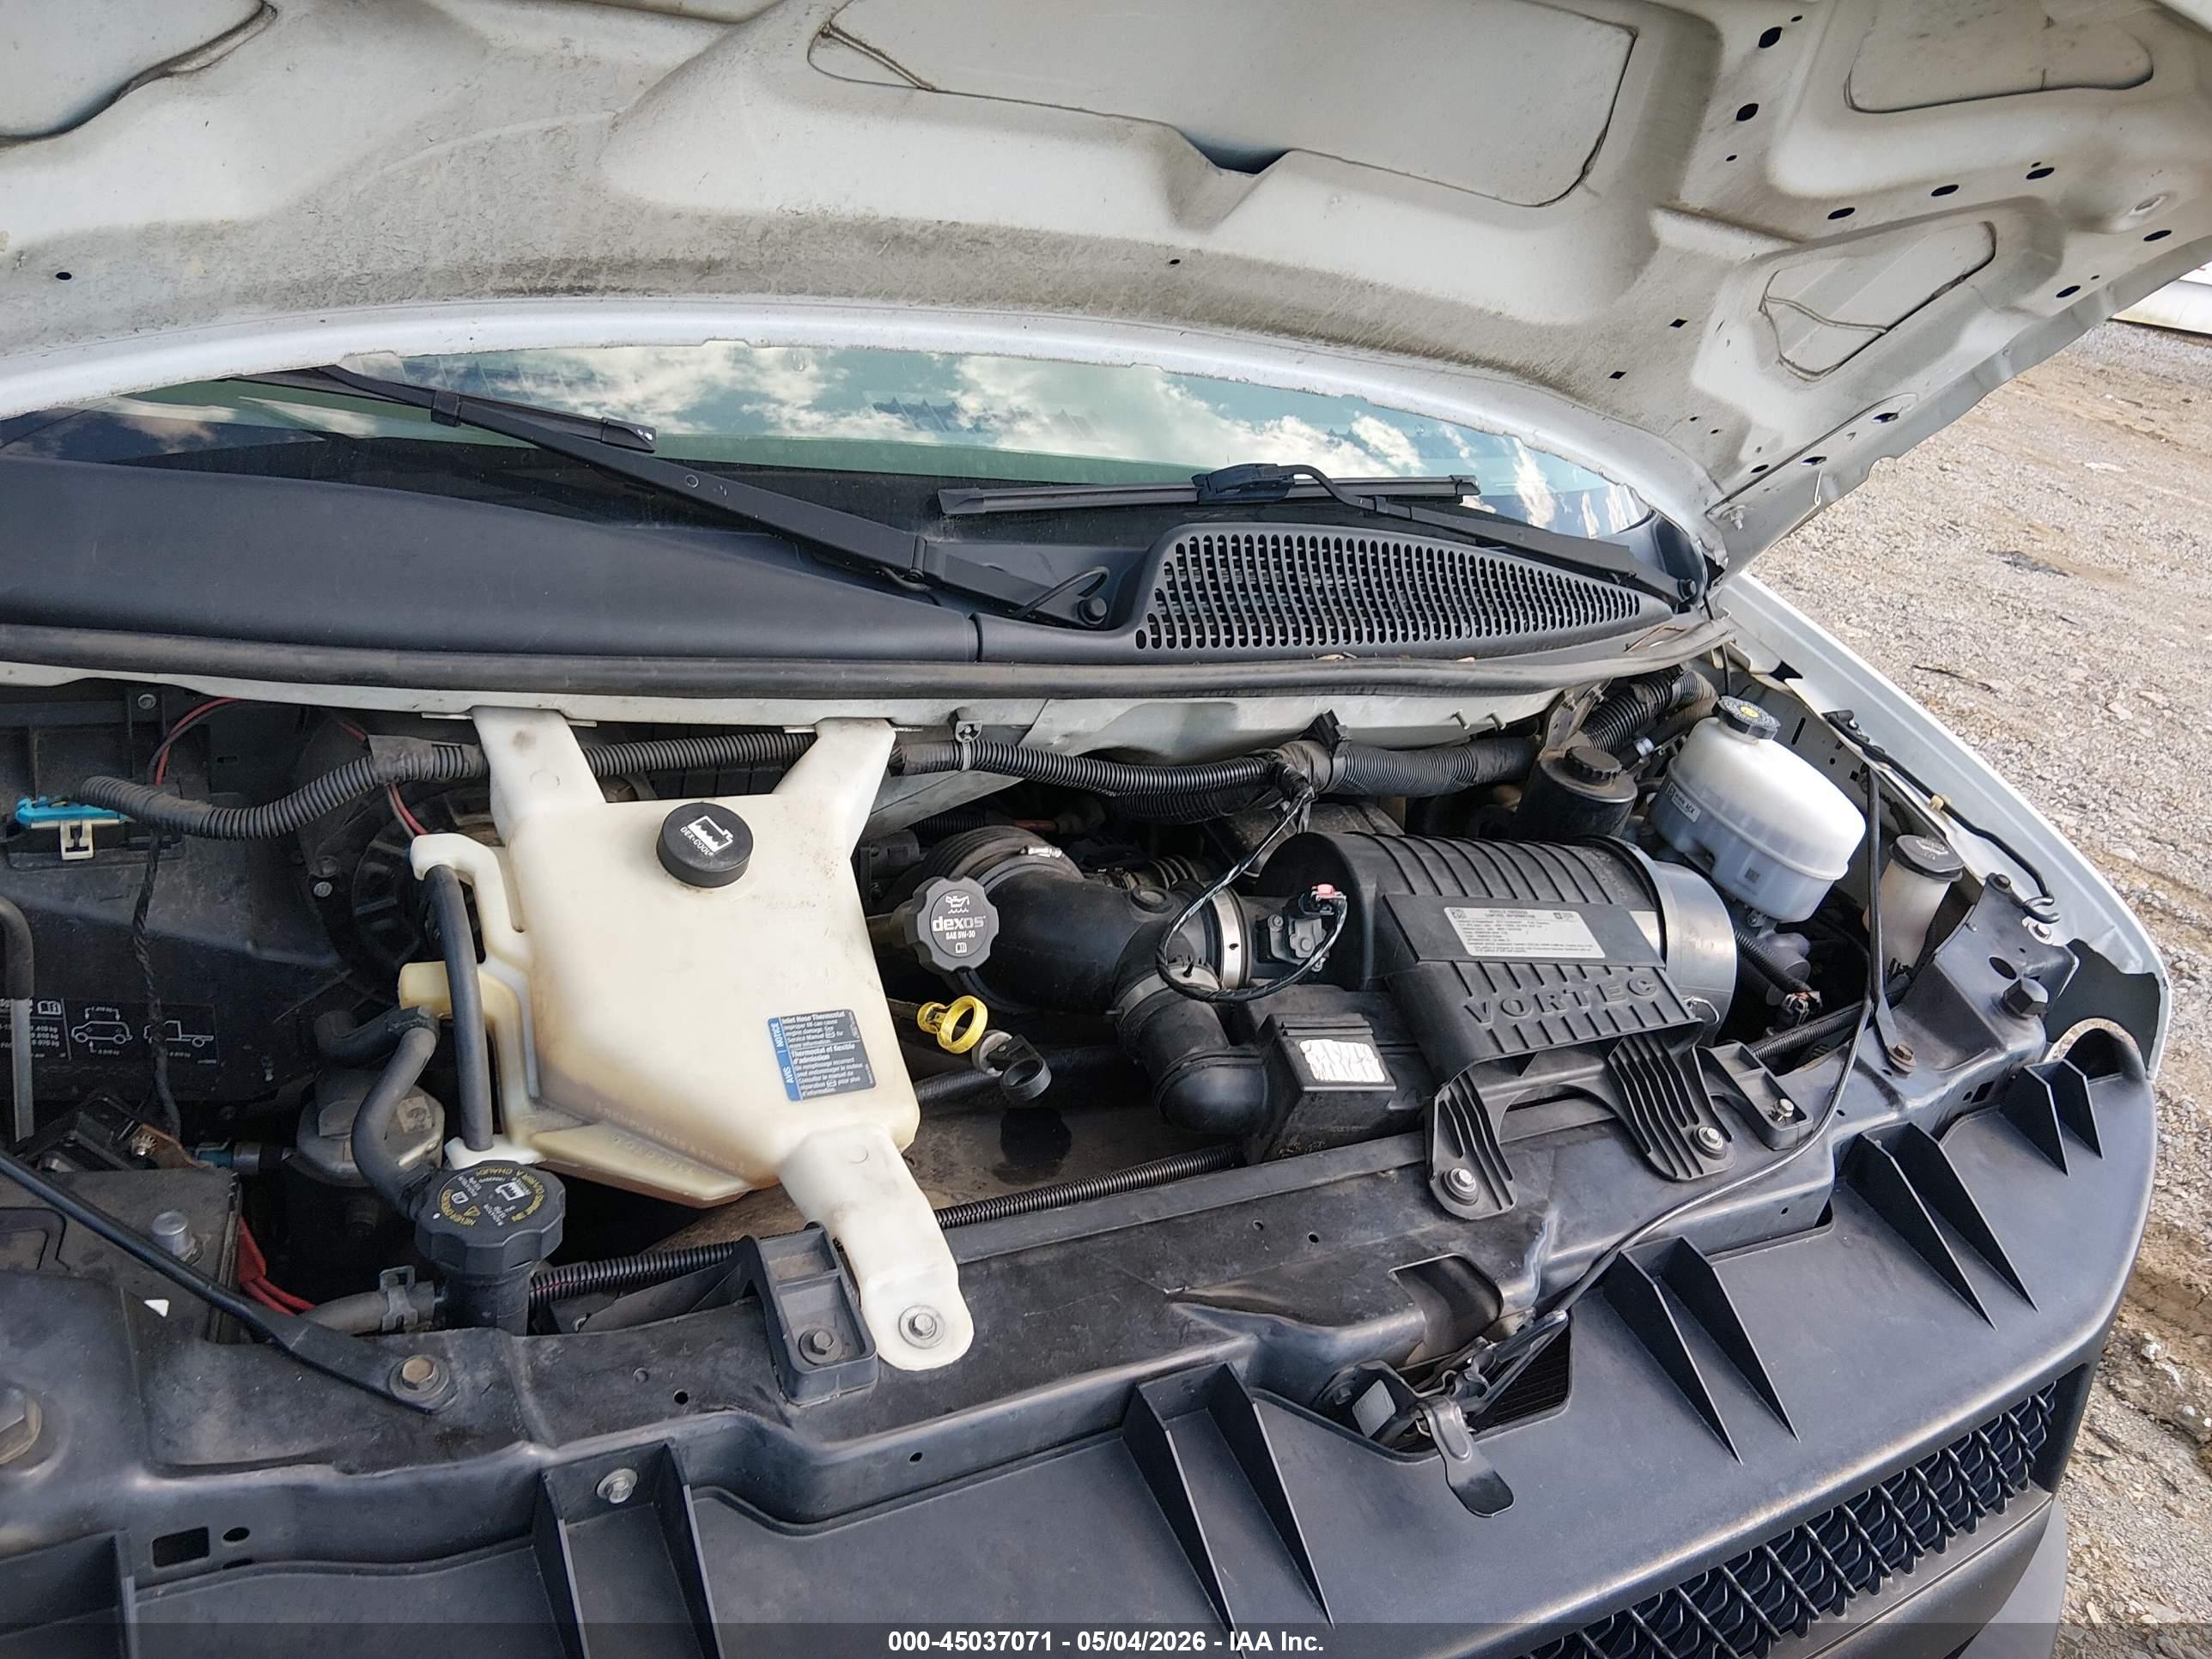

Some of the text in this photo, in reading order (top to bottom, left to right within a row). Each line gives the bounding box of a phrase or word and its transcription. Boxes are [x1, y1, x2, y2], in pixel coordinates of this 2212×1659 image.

[1463, 976, 1657, 1024] VORTEC
[771, 1023, 784, 1048] NOTICE
[783, 1066, 795, 1084] AVIS
